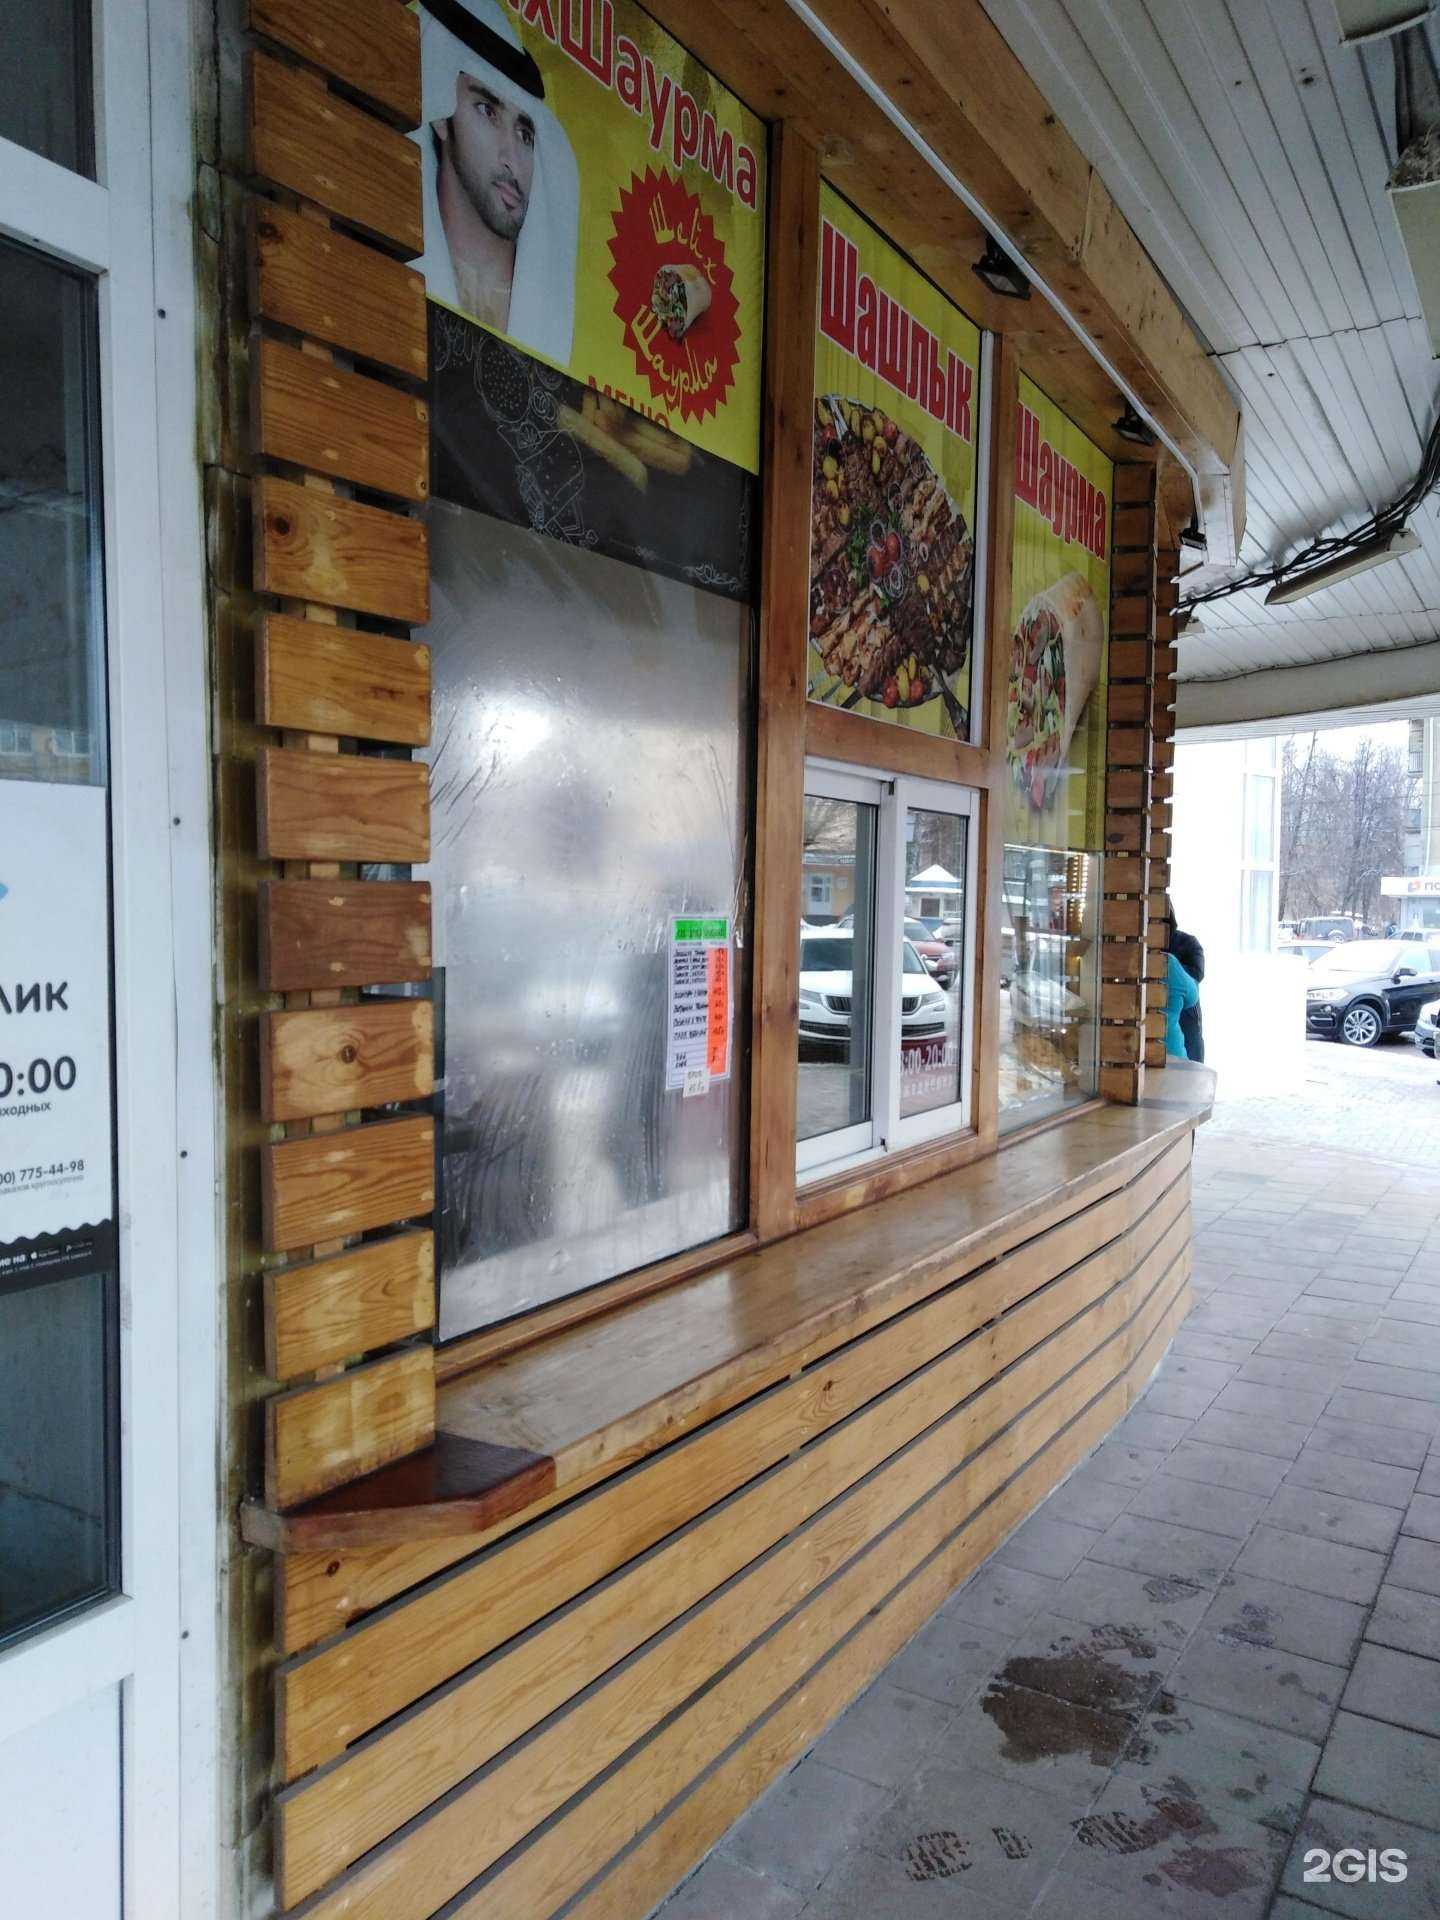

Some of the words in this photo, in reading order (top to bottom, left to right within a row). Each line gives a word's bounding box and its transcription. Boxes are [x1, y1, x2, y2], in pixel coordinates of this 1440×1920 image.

[507, 0, 757, 212] хШаурма
[631, 304, 718, 408] Шаурма
[819, 214, 974, 445] Шашлык
[1015, 400, 1107, 561] Шаурма
[0, 1102, 52, 1117] ходных
[20, 1159, 85, 1182] 775-44-98
